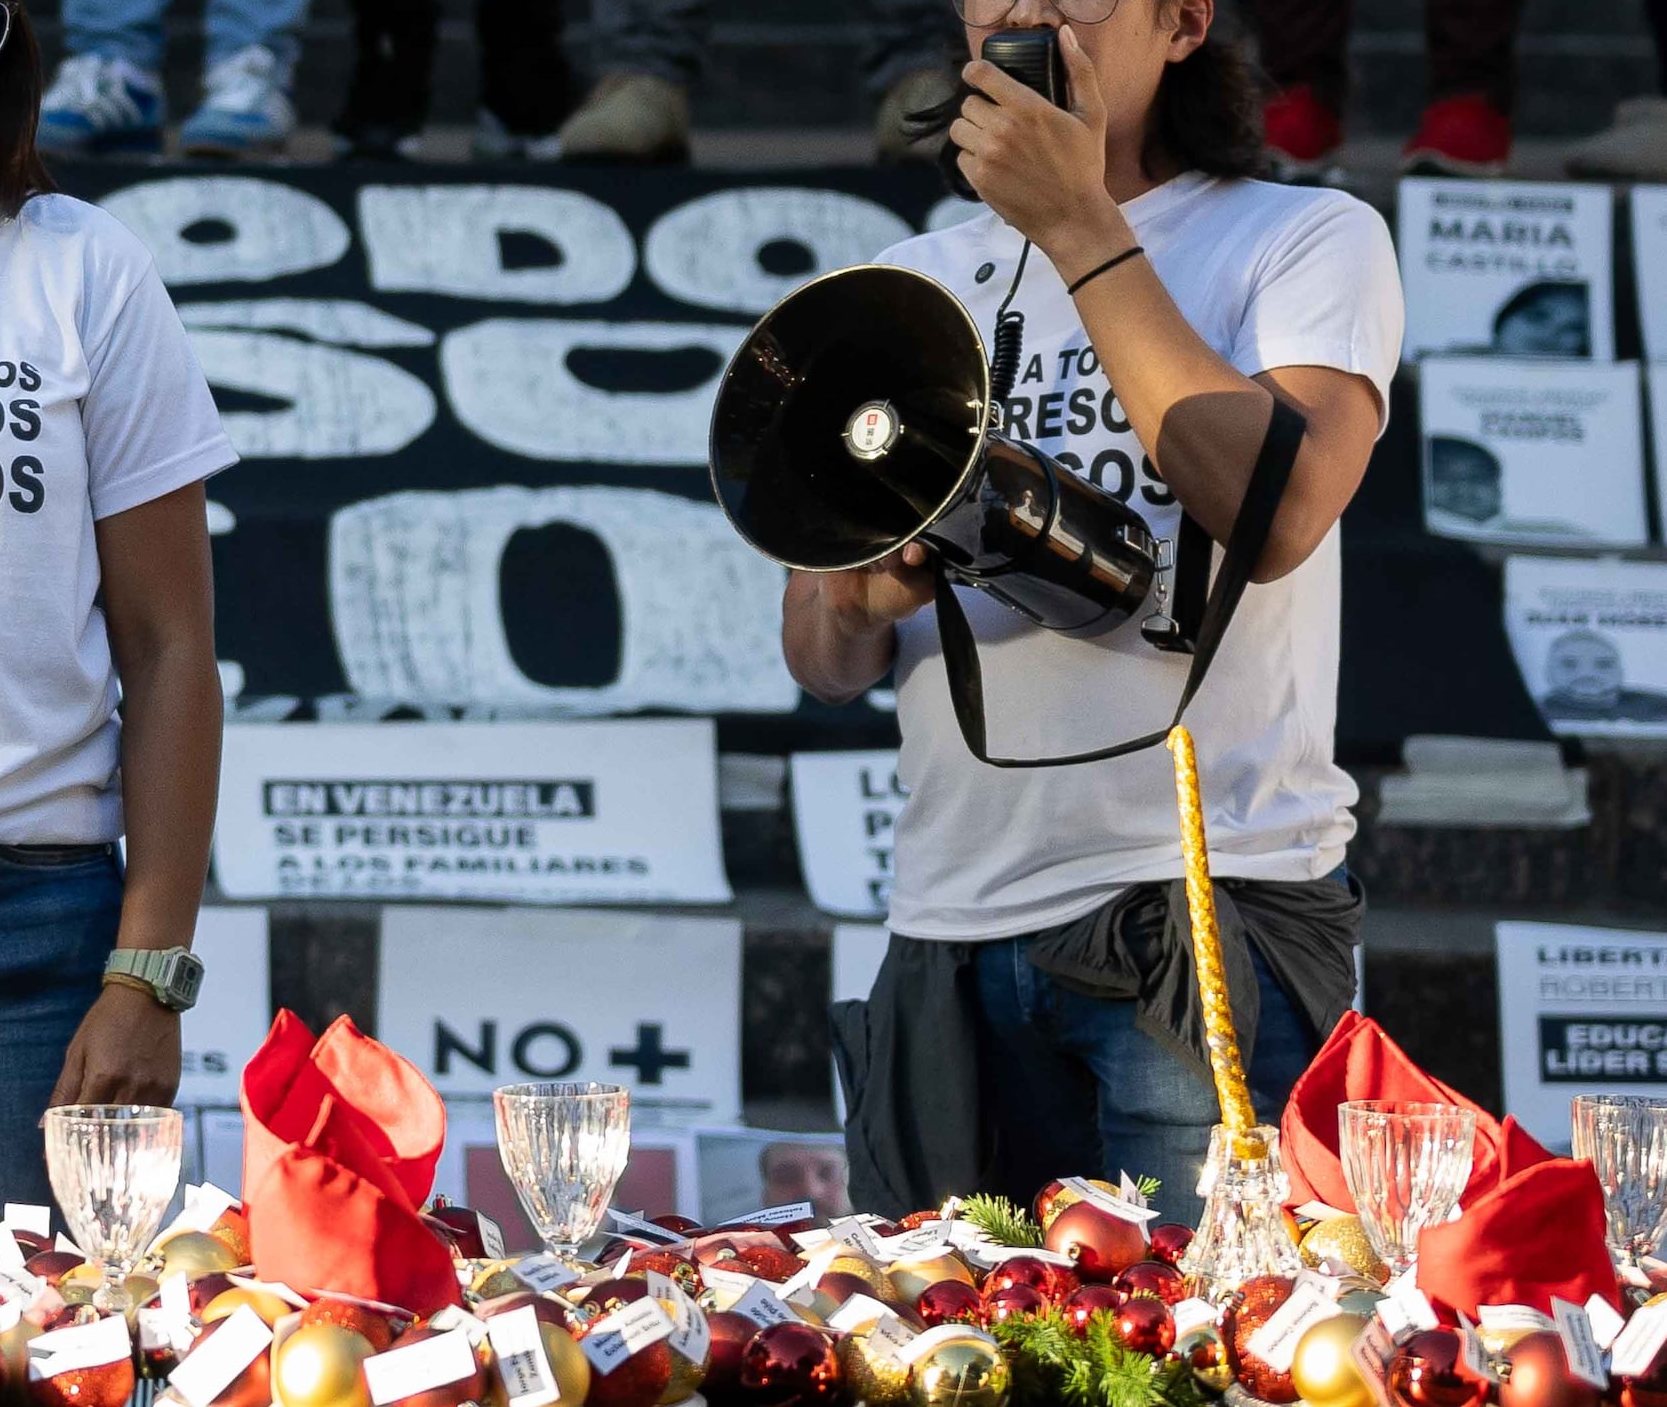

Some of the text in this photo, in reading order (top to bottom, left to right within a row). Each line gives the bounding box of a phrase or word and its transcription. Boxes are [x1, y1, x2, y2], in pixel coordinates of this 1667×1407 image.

[1005, 387, 1134, 440] RESO
[273, 823, 537, 849] SE PERSIGUE
[277, 855, 650, 875] A LOS FAMILIARES
[1536, 946, 1667, 966] LIBERT
[432, 1019, 584, 1078] NO
